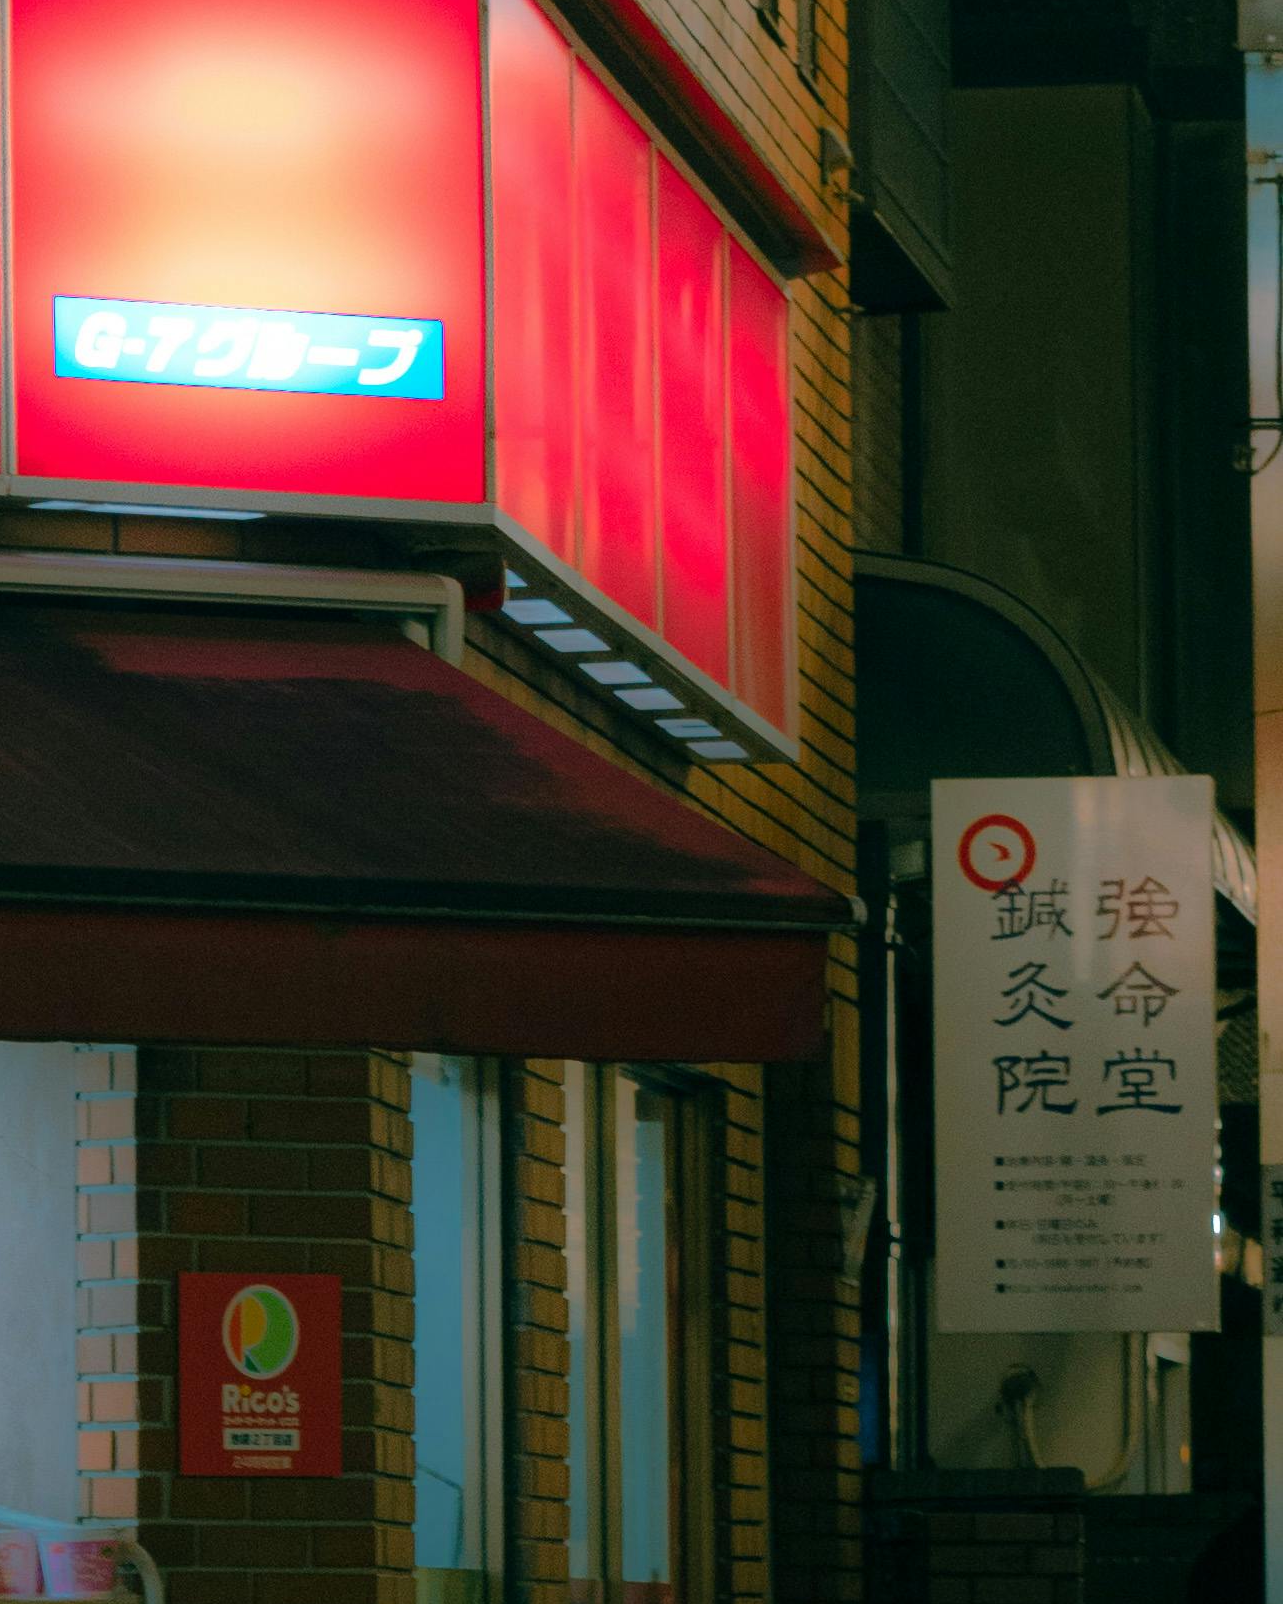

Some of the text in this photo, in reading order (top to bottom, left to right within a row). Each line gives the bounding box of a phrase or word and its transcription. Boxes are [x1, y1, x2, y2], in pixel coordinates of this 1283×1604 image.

[991, 876, 1078, 1117] 鍼灸院
[1095, 874, 1184, 1118] 強命堂
[221, 1383, 301, 1414] Rico's
